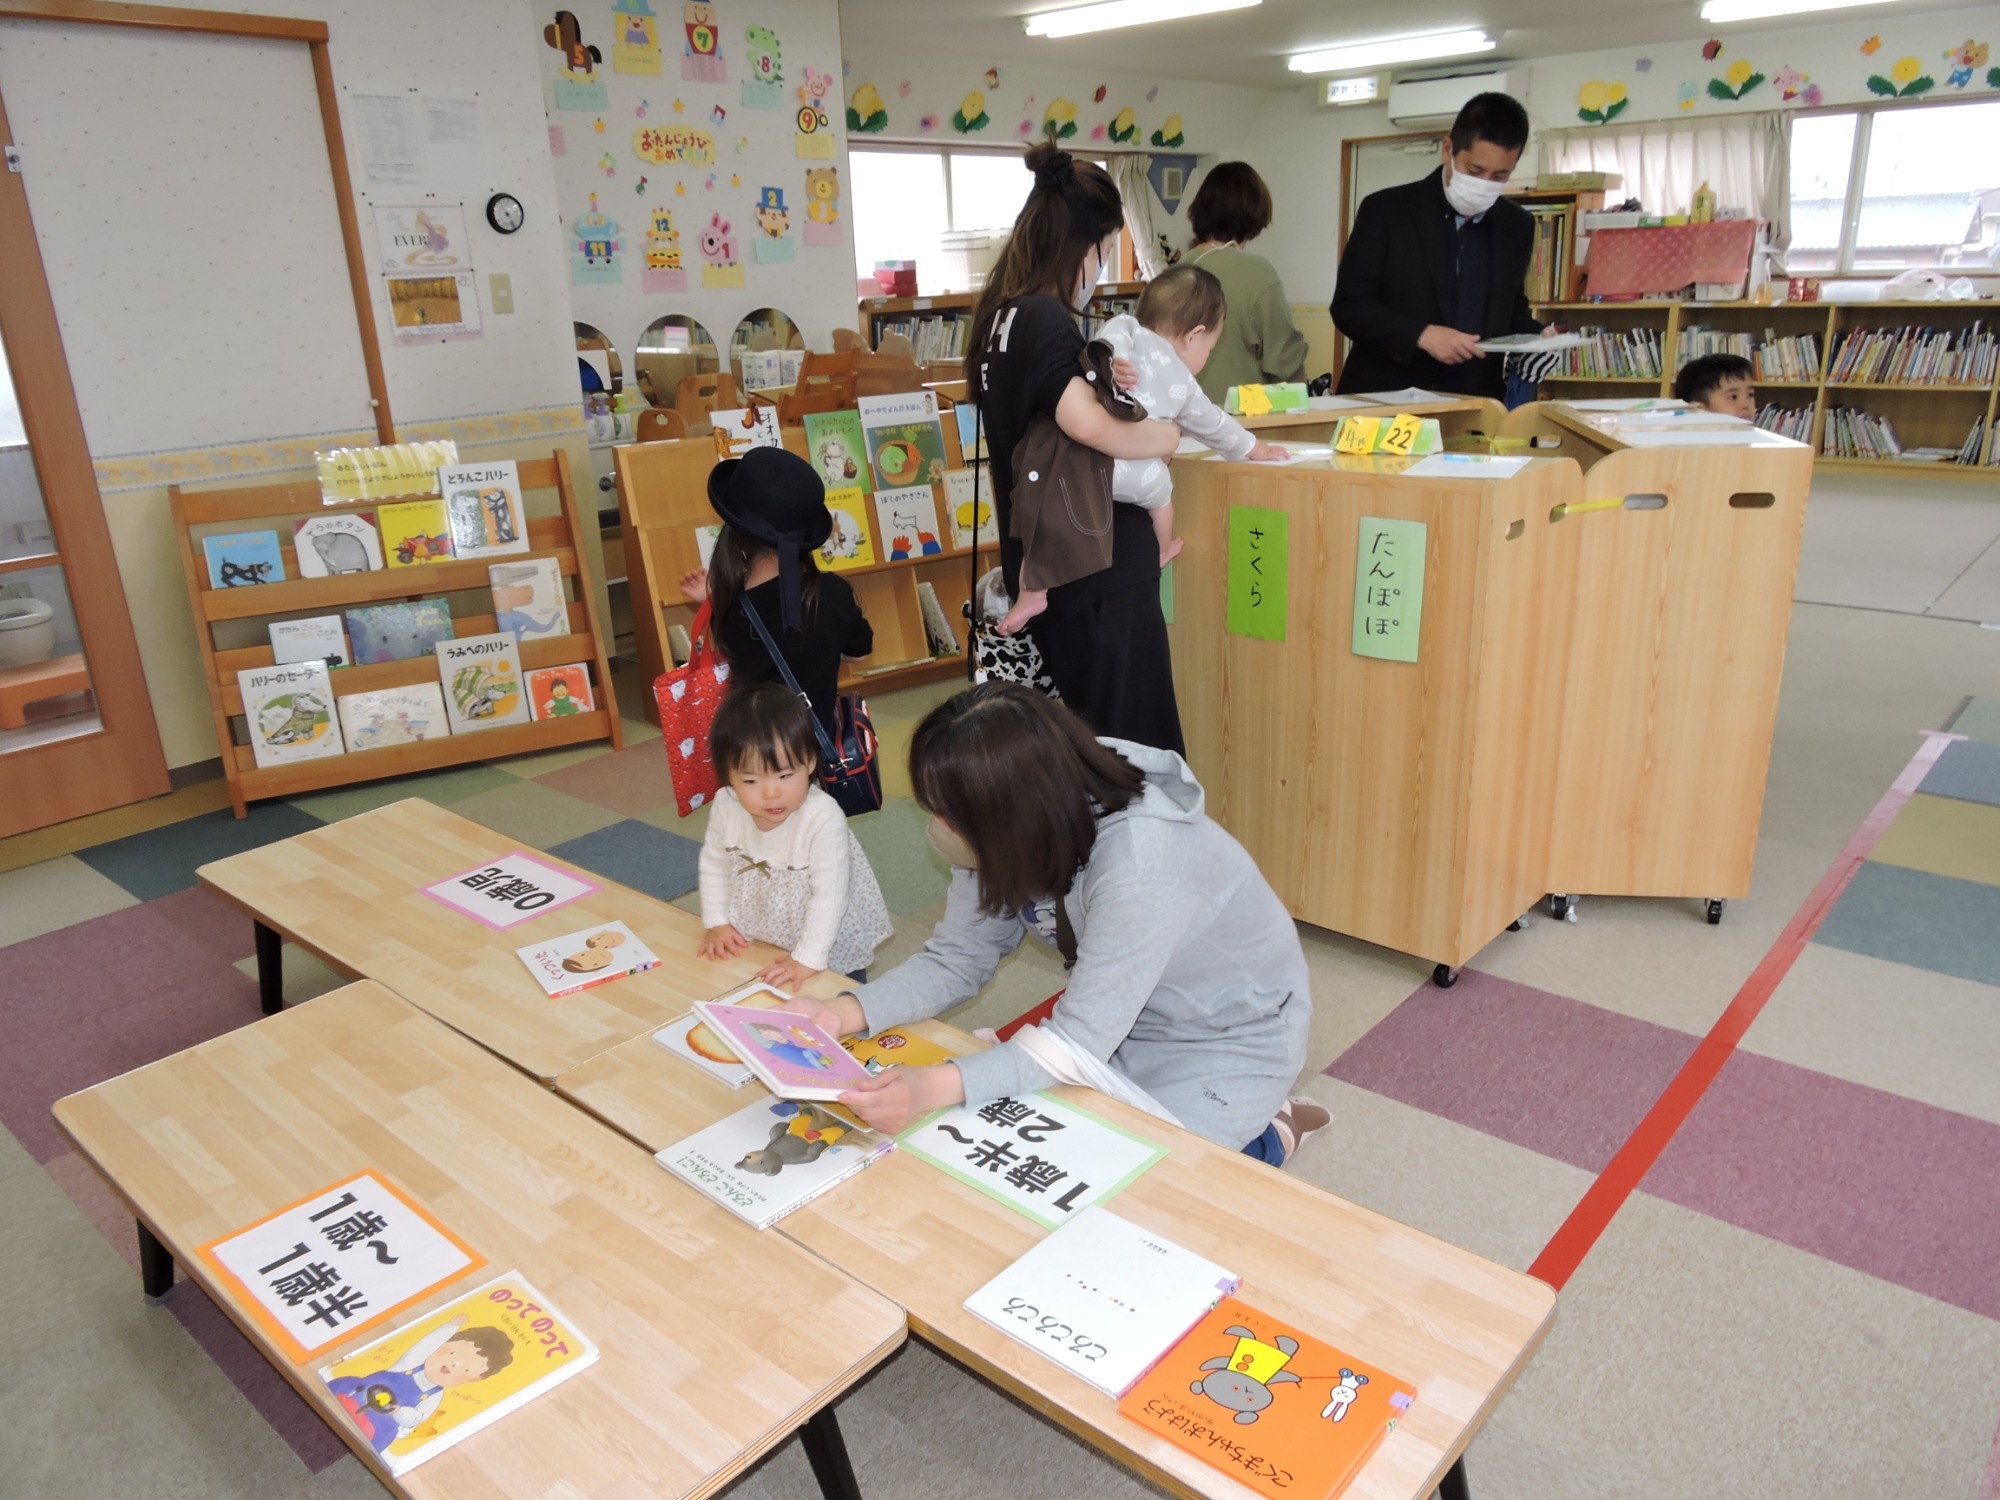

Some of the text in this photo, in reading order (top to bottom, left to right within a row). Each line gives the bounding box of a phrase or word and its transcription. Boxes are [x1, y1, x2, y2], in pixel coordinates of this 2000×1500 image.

[696, 32, 708, 48] 7
[573, 44, 585, 65] 5
[761, 56, 770, 73] 8
[802, 111, 814, 129] 9
[641, 130, 711, 151] おたんじょうび
[768, 190, 777, 206] 2
[655, 218, 670, 232] 12
[590, 242, 606, 255] 11
[722, 242, 730, 259] 1
[1387, 427, 1412, 449] 22
[447, 470, 510, 484] どろんこハリー
[880, 491, 929, 505] ぼくのやぎさん
[1249, 527, 1264, 607] さくら
[1365, 532, 1401, 635] たんぽぽ
[251, 669, 321, 688] ハリーのセーター
[459, 867, 555, 911] 0歳児
[977, 1096, 1067, 1143] 2歳
[715, 1182, 754, 1207] どろんこ
[257, 1241, 369, 1329] 1歳半
[489, 1288, 569, 1358] のって のって
[1002, 1297, 1108, 1363] ころころころ
[1142, 1398, 1294, 1488] こぐまちゃんおはよう
